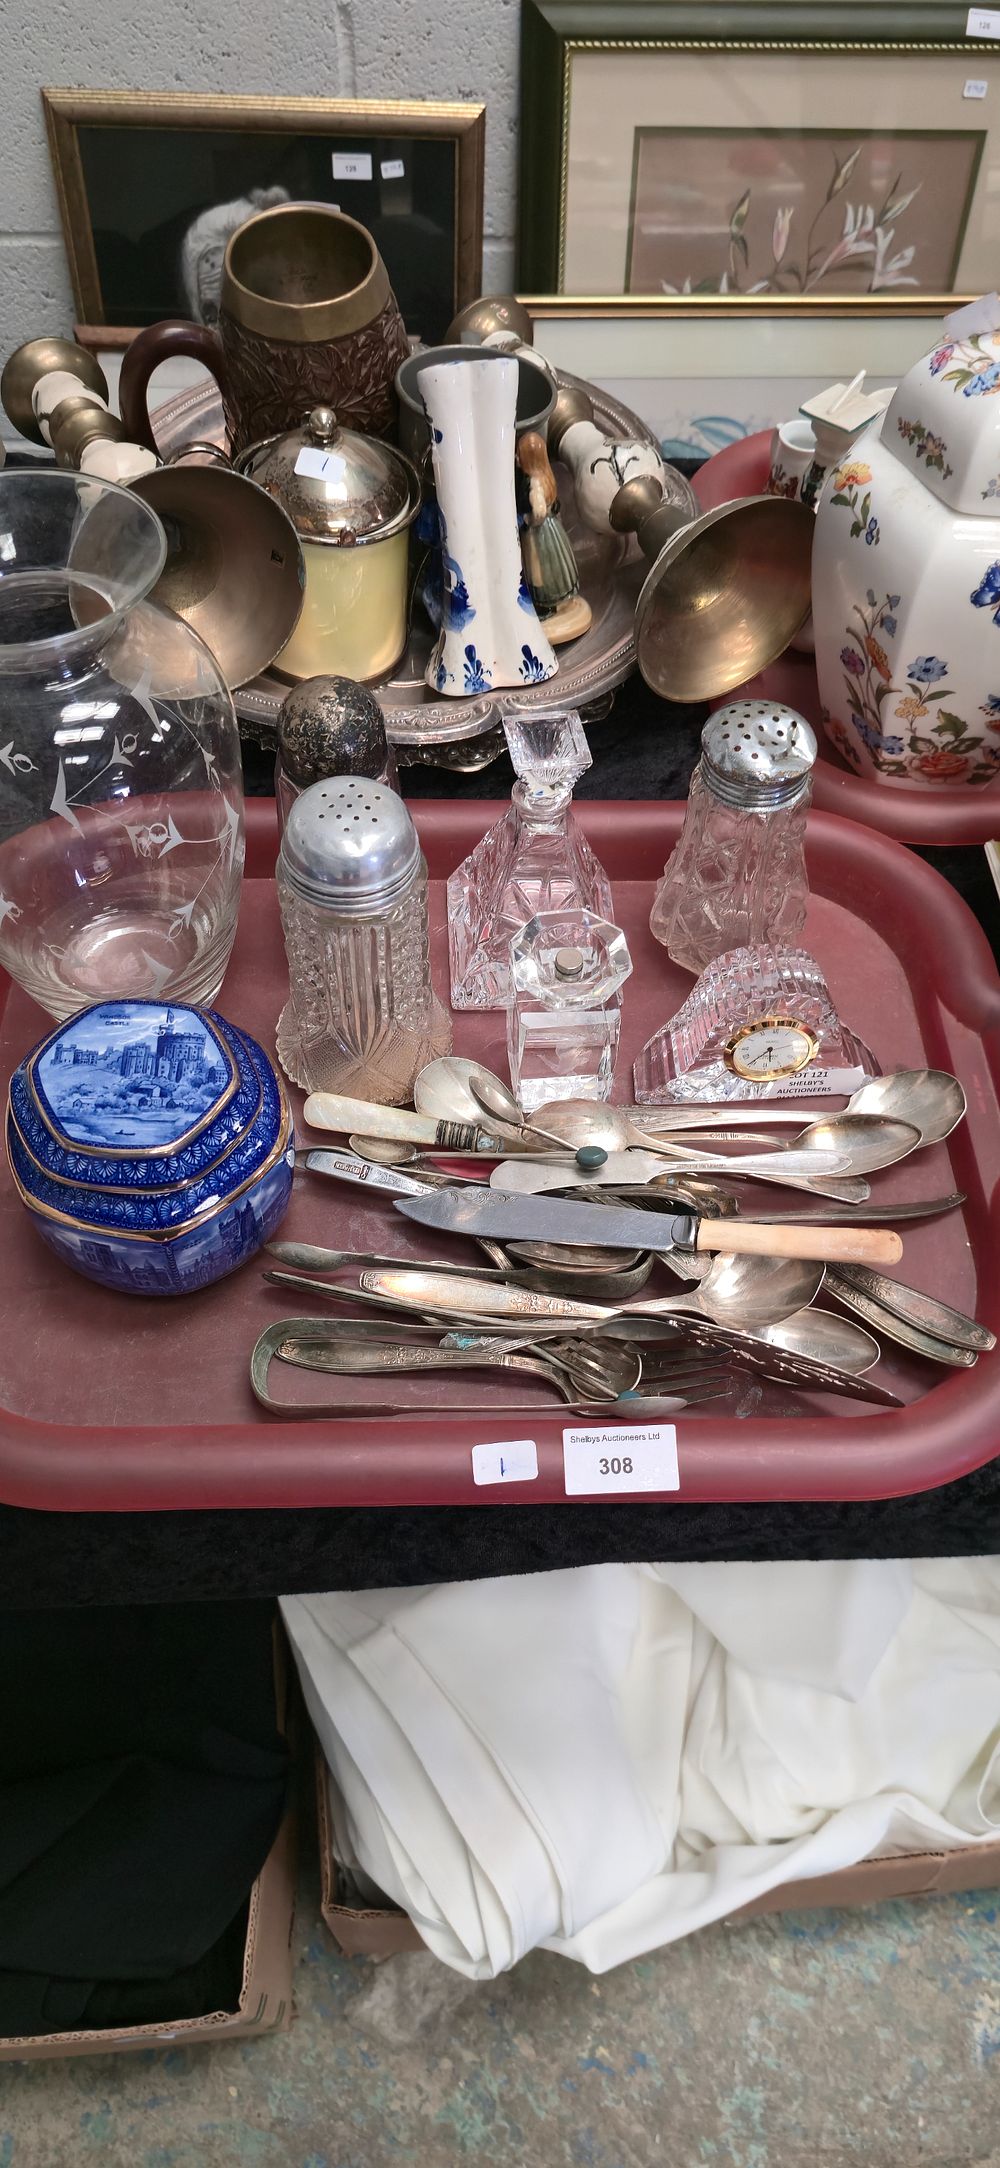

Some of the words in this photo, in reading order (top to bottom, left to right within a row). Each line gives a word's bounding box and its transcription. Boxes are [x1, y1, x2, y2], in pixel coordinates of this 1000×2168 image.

[776, 1086, 832, 1094] AUCTIONEERS
[570, 1434, 600, 1444] Shelbys
[601, 1433, 646, 1442] Auctioneers
[648, 1432, 660, 1441] Ltd
[598, 1456, 634, 1475] 308
